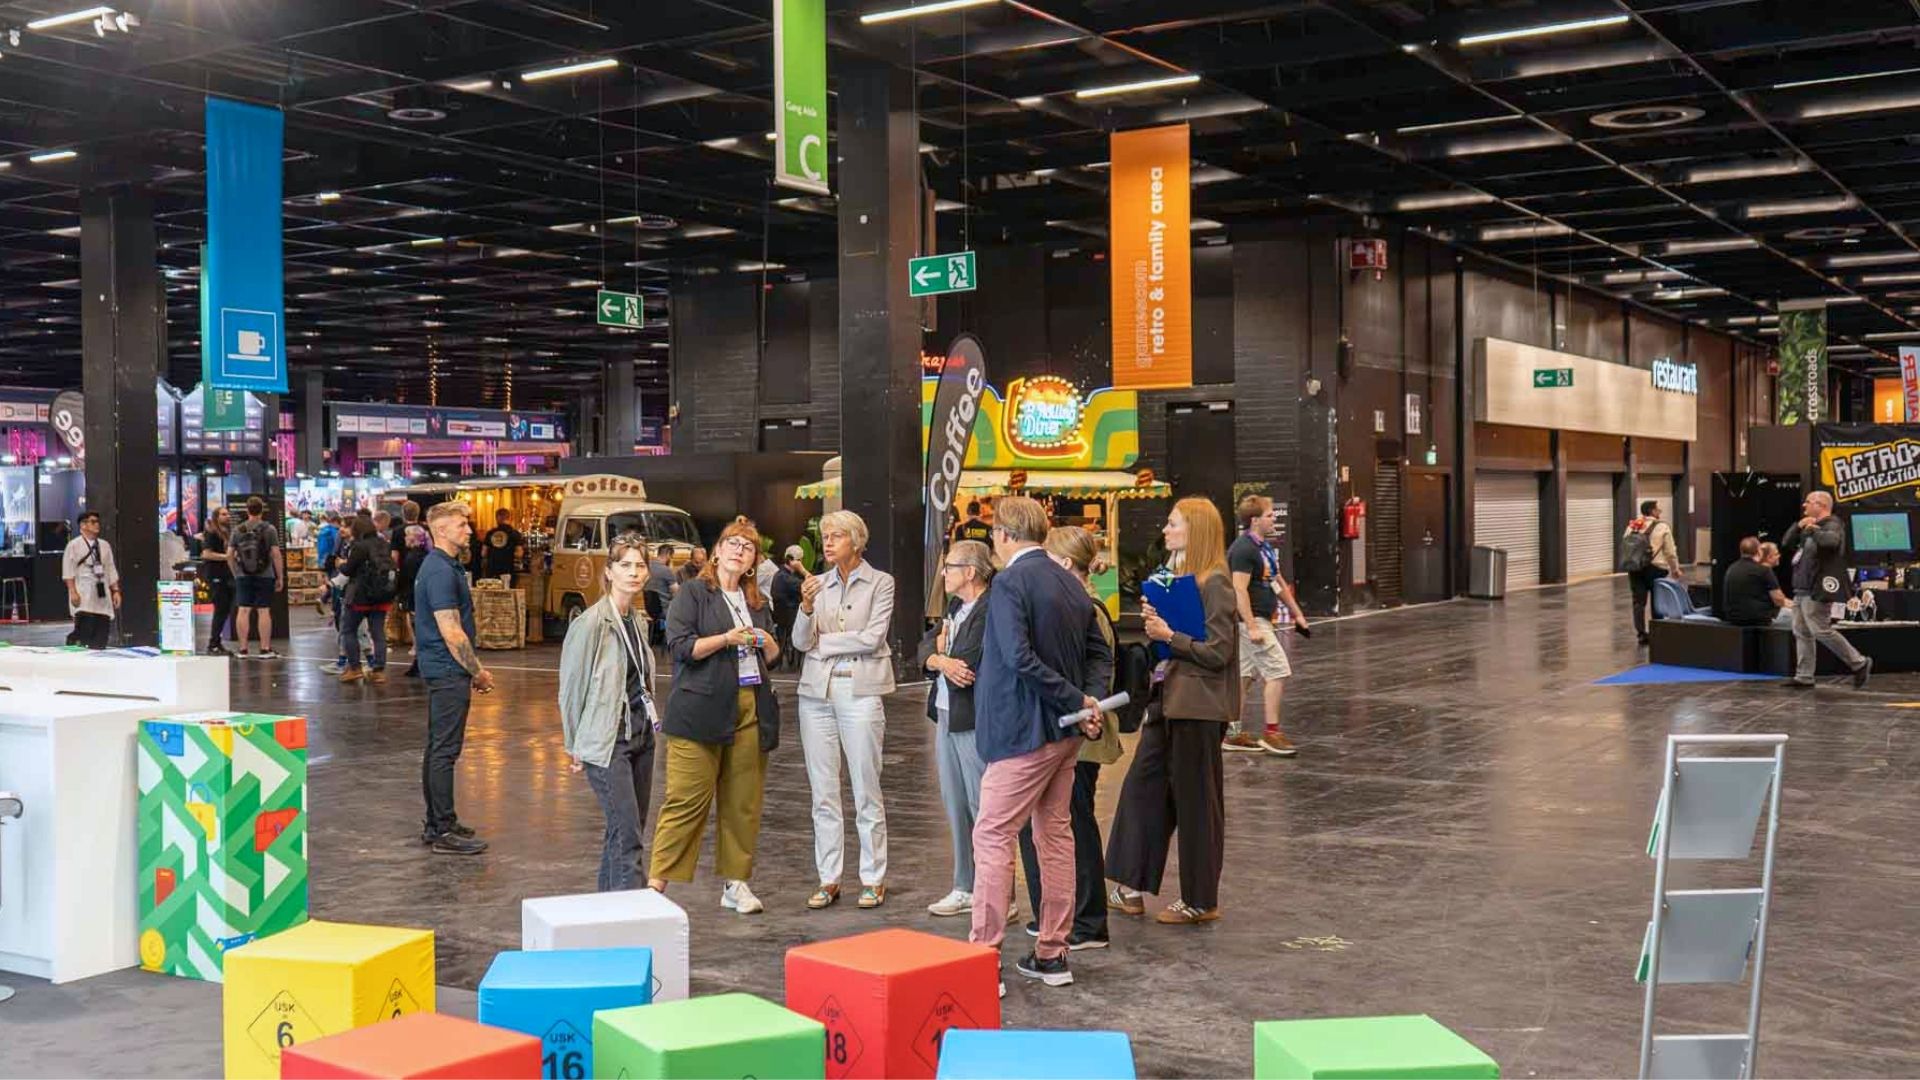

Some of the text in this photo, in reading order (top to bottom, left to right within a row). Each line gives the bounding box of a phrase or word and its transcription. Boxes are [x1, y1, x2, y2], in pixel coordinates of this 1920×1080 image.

[799, 134, 821, 182] C
[1148, 166, 1167, 354] retro & family area
[1135, 259, 1152, 368] gamescom
[1652, 356, 1698, 393] restaurant
[1805, 348, 1818, 421] crossroads
[930, 367, 985, 513] Coffee
[1833, 443, 1914, 483] RETRO
[572, 478, 640, 495] Coffee
[274, 1002, 296, 1013] USK
[389, 990, 403, 1003] USK
[276, 1021, 295, 1049] 6
[550, 1032, 576, 1044] USK
[824, 1029, 847, 1064] 18
[542, 1051, 585, 1080] 16
